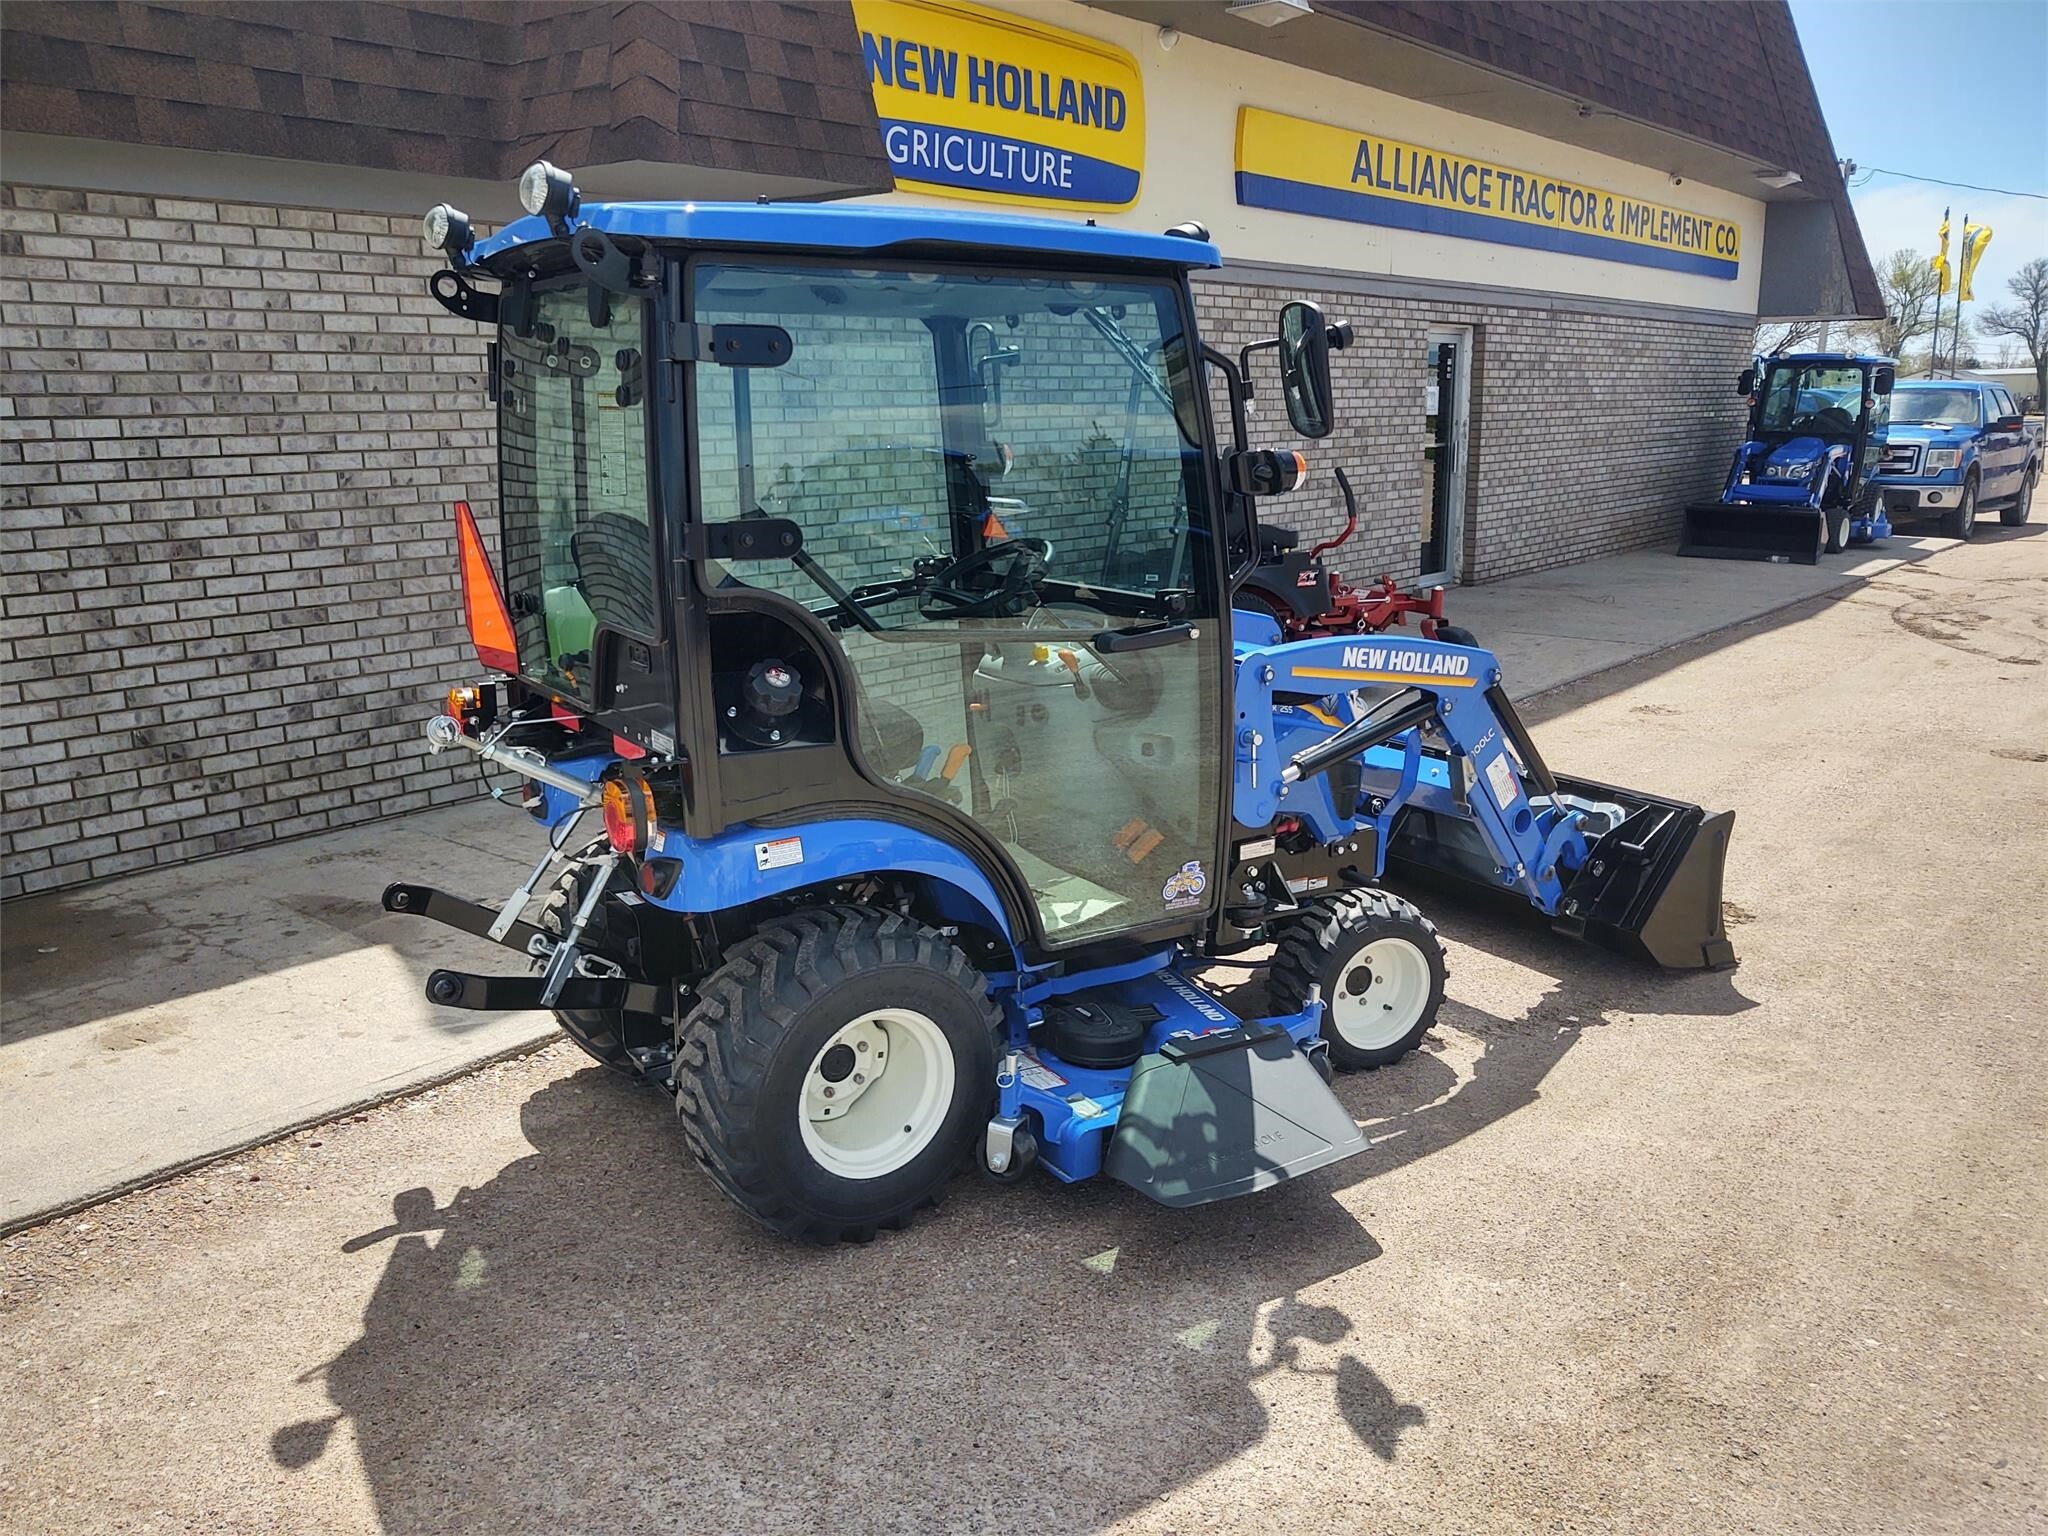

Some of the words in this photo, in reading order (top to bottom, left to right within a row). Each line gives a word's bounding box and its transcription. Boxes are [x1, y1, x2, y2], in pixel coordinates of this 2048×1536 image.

[862, 31, 958, 99] NEW
[968, 55, 1126, 132] HOLLAND
[885, 125, 1073, 189] GRICULTURE
[1351, 138, 1493, 209] ALLIANCE
[1496, 170, 1598, 229] TRACTOR
[1602, 196, 1615, 233] &
[1620, 200, 1713, 251] IMPLEMENT
[1715, 223, 1738, 257] CO.
[1342, 646, 1387, 670] NEW
[1388, 650, 1469, 676] HOLLAND
[1155, 968, 1183, 987] NEW
[1171, 986, 1227, 1022] HOLLAND
